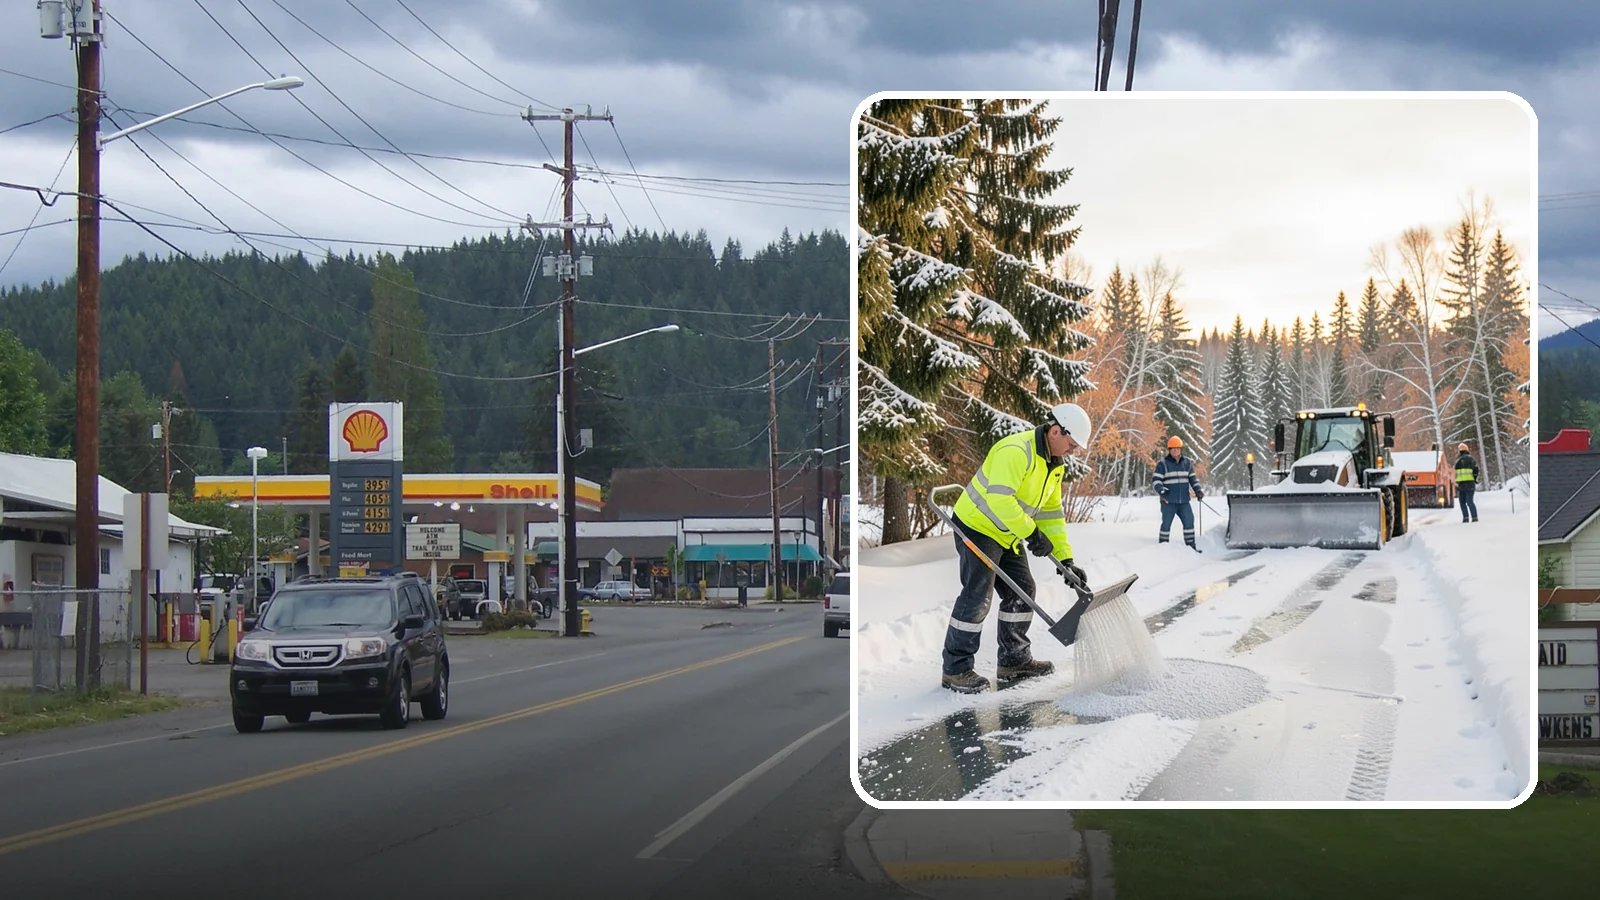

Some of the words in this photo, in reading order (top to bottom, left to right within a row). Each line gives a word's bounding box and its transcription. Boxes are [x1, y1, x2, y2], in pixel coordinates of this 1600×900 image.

[366, 480, 384, 490] 395
[490, 484, 547, 499] Shell
[366, 494, 384, 504] 405
[366, 508, 384, 518] 415
[366, 522, 384, 532] 429
